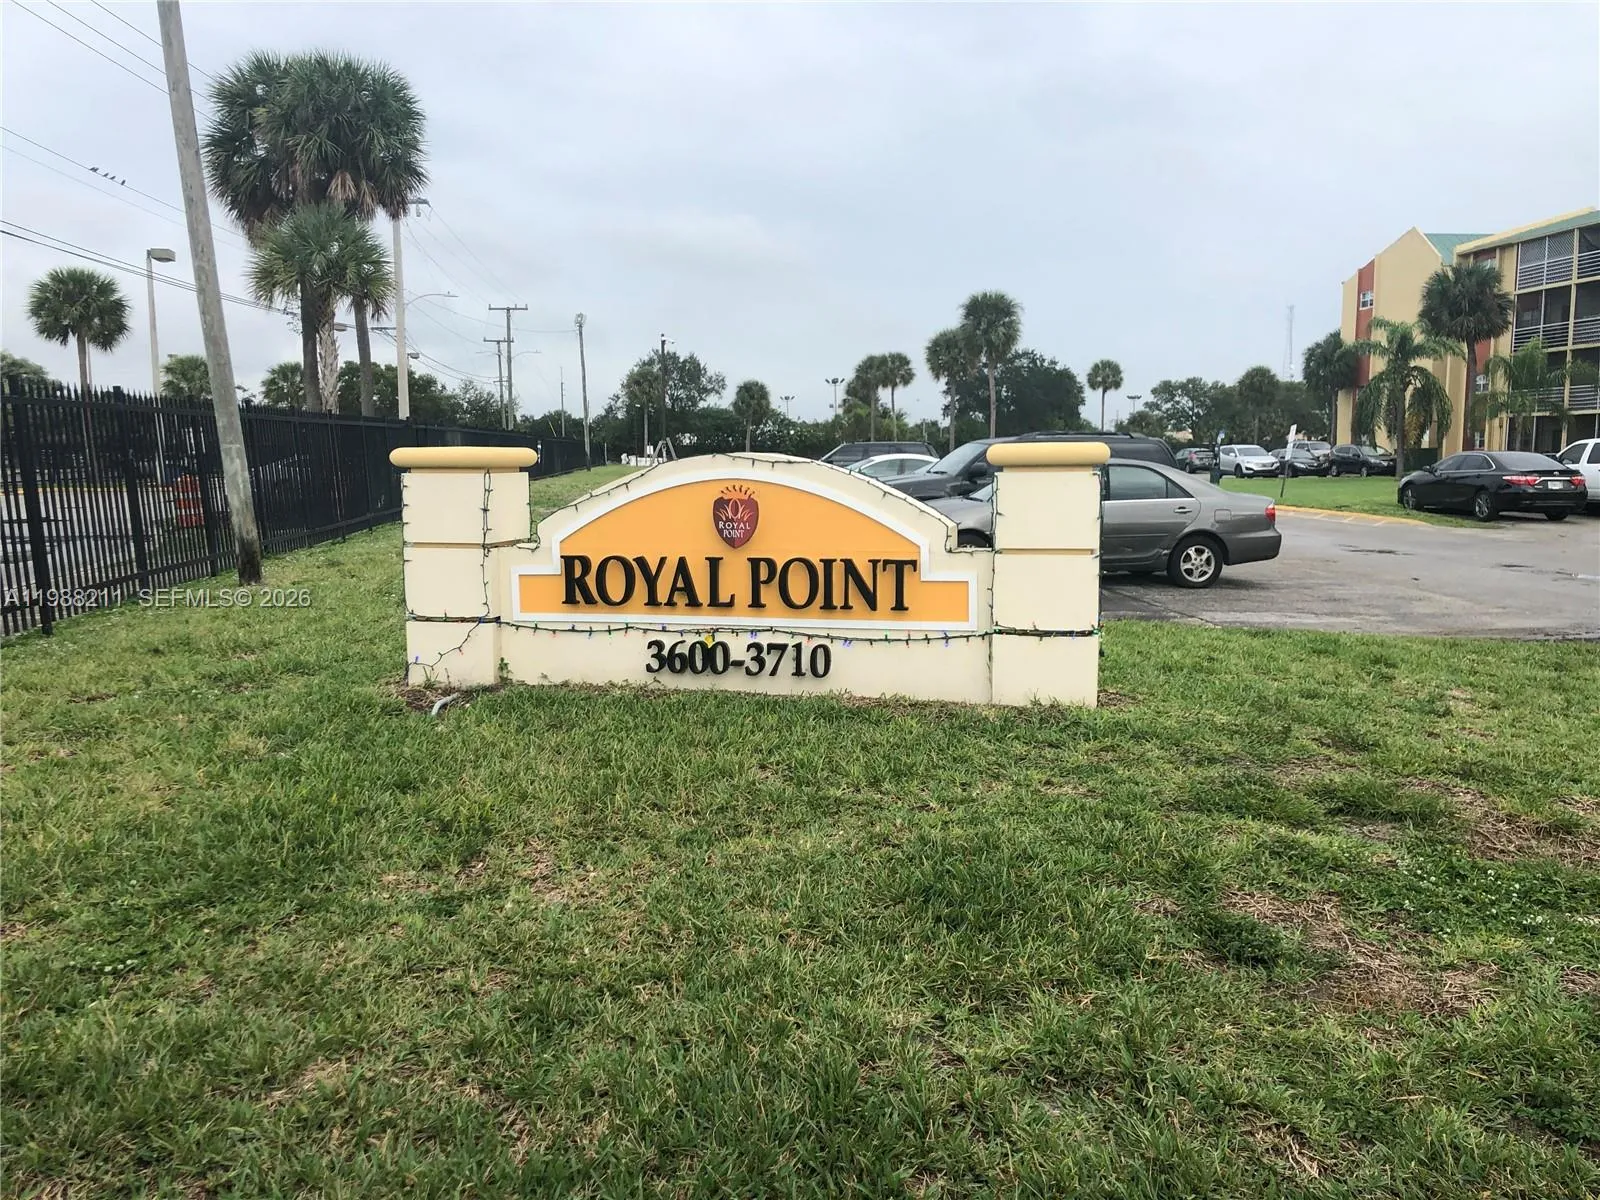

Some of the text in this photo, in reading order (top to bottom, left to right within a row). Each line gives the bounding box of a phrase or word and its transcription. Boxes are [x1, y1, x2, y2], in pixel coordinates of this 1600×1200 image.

[718, 521, 751, 530] ROYAL
[723, 529, 745, 538] POINT
[560, 554, 918, 612] ROYAL POINT
[645, 639, 832, 679] 3600-3710
